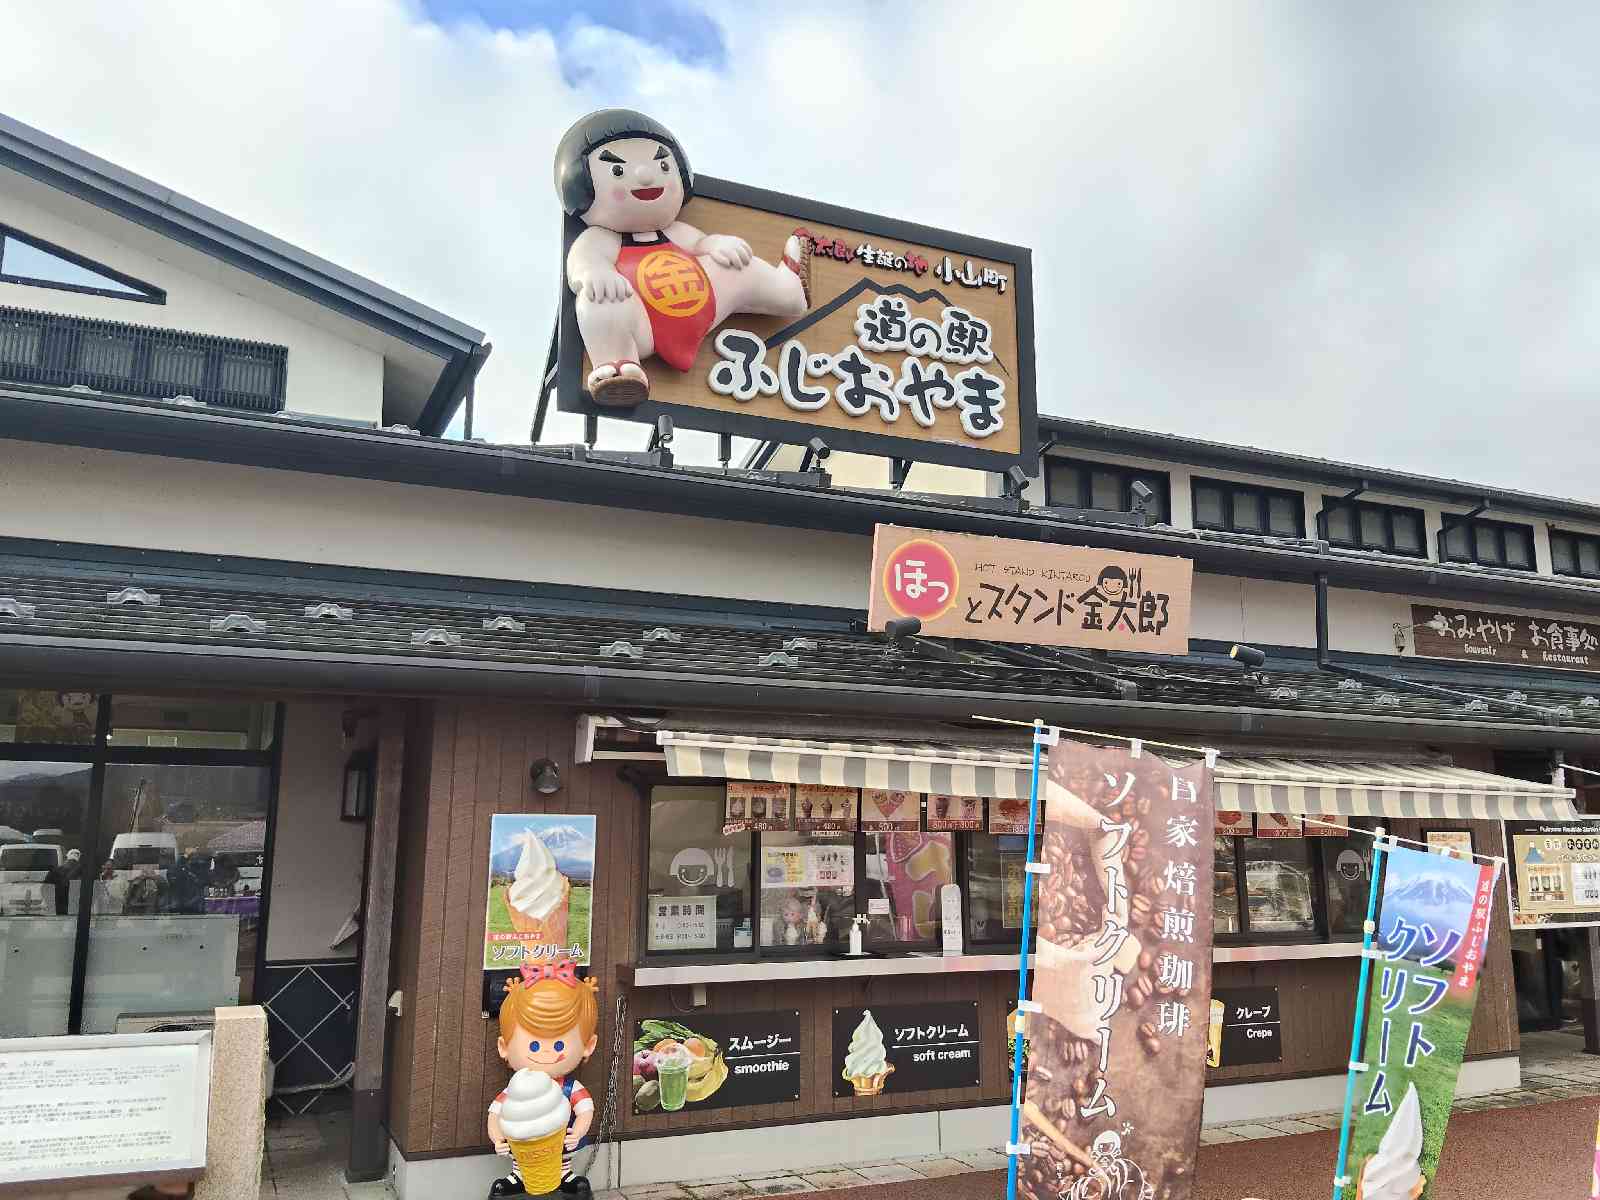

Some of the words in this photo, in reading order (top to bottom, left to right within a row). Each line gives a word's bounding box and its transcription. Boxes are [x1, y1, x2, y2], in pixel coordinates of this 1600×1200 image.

[644, 252, 705, 310] 金
[933, 255, 1008, 295] 小山町
[856, 295, 994, 365] 道の駅
[708, 329, 1007, 438] ふじおやま
[894, 559, 950, 603] ほっ
[1003, 565, 1036, 577] STAND
[1428, 611, 1516, 645] おみやげ
[1528, 621, 1599, 653] お食事処
[1542, 651, 1589, 665] Restaurant
[492, 943, 585, 961] ソフトクリーム
[1080, 770, 1137, 1119] ソフトクリーム
[1236, 1006, 1271, 1020] クレープ
[1403, 922, 1464, 1068] ソフト
[894, 1023, 969, 1042] ソフトクリーム
[1364, 916, 1420, 1117] クリーム
[728, 1034, 792, 1051] スムージー
[912, 1051, 936, 1062] soft
[937, 1049, 971, 1060] cream
[734, 1060, 790, 1075] smoothie
